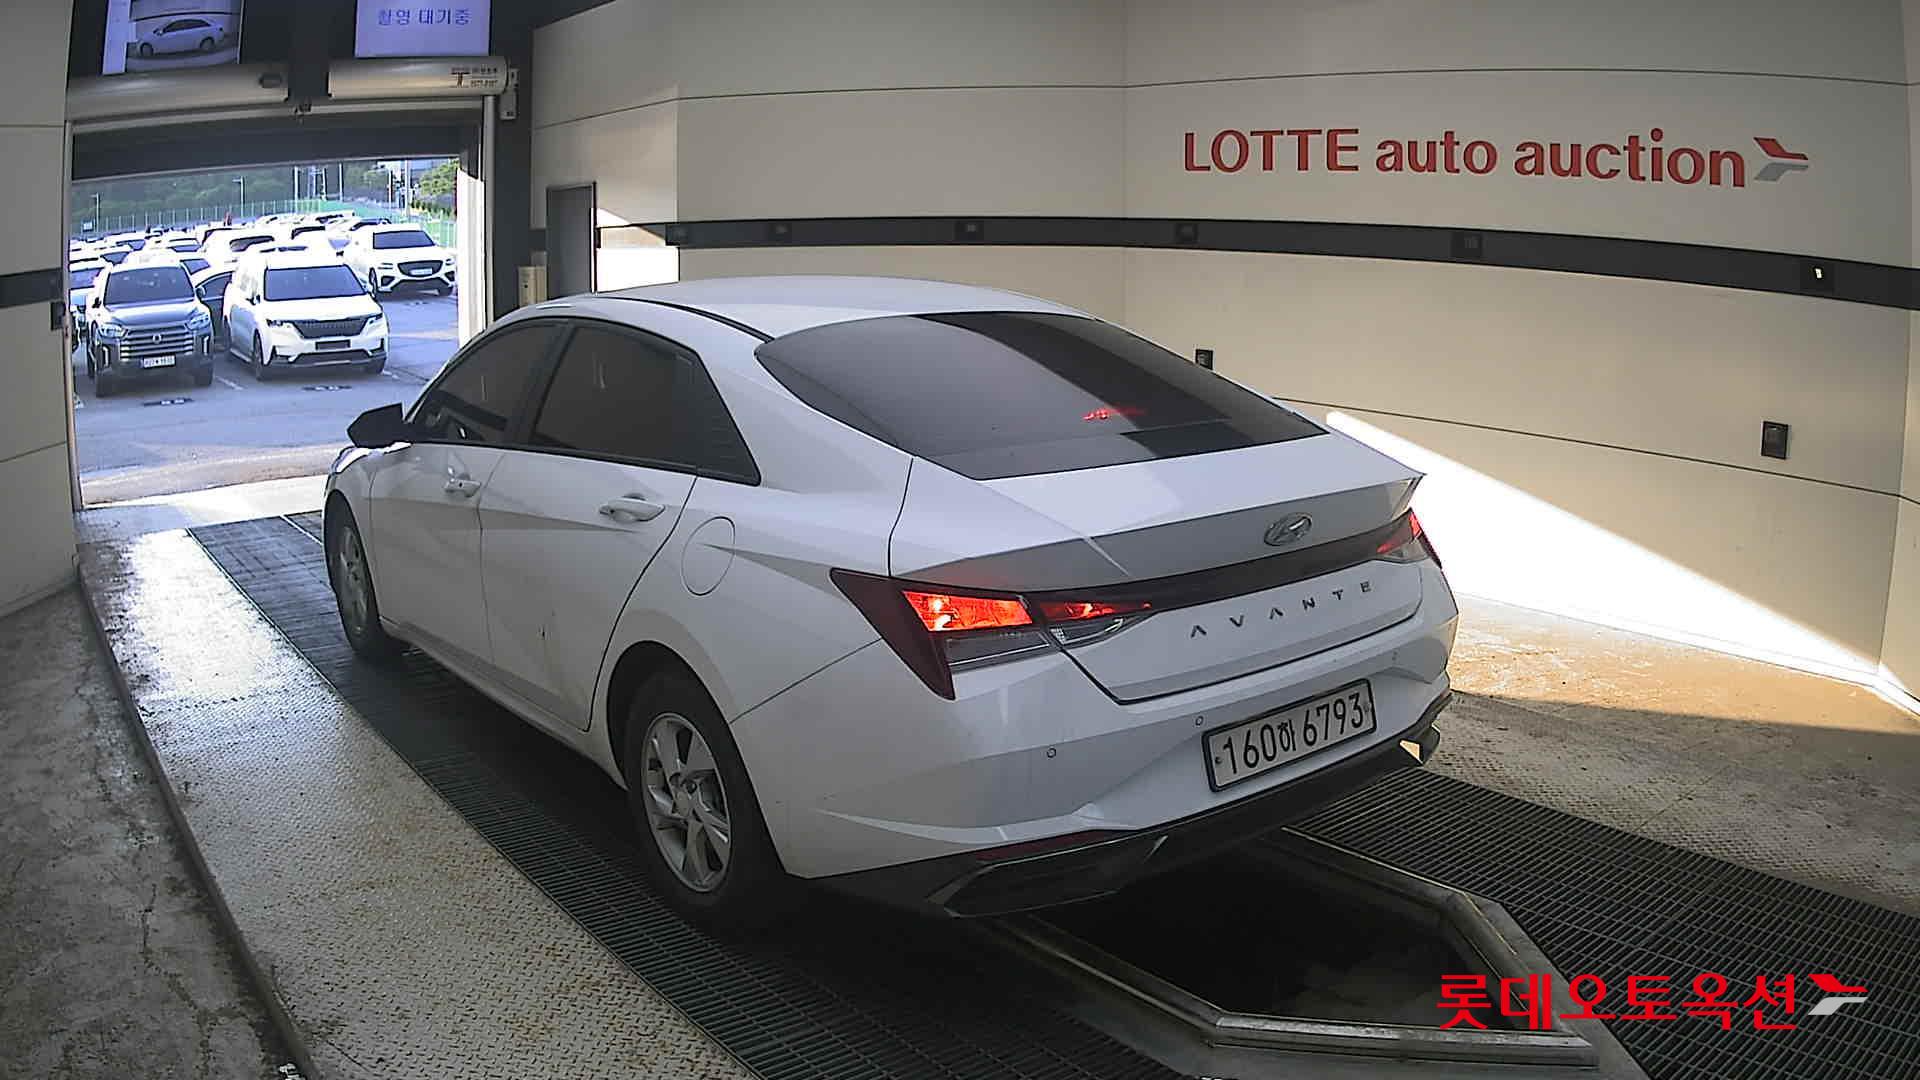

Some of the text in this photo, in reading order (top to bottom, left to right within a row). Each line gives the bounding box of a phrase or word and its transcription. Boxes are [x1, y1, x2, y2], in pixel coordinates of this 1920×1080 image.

[418, 8, 472, 26] 대기중
[1184, 128, 1746, 188] LOTTE auto auction
[1190, 581, 1373, 638] AVANTE
